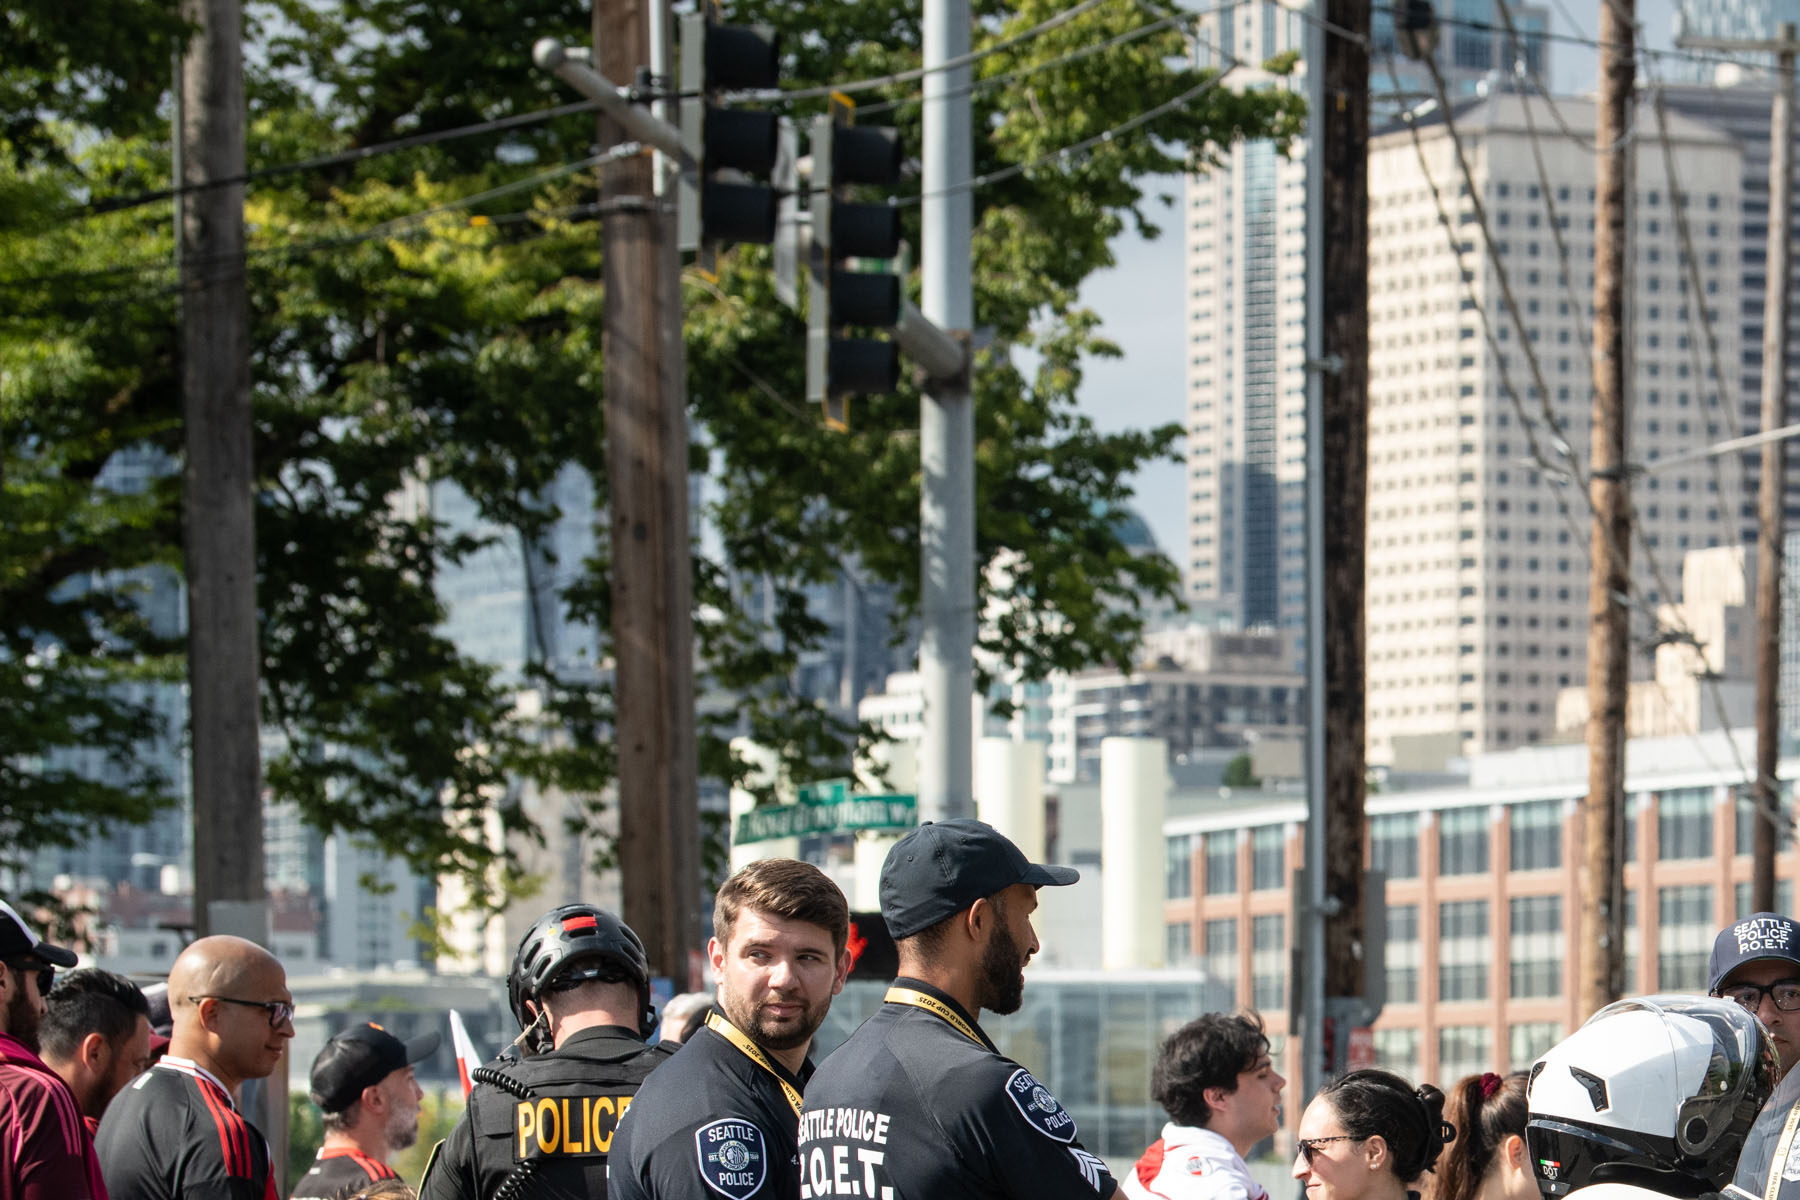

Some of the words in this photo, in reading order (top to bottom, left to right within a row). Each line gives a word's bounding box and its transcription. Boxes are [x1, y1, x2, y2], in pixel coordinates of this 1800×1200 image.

[1733, 918, 1793, 936] SEATTLE
[1737, 928, 1789, 945] POLICE
[1739, 938, 1789, 955] P.O.E.T.
[919, 996, 937, 1008] 2025
[936, 1006, 950, 1016] CUP
[745, 1044, 760, 1058] 2025
[836, 1107, 891, 1145] POLICE
[1043, 1111, 1071, 1131] POLICE
[707, 1125, 755, 1142] SEATTLE
[718, 1172, 755, 1186] POLICE
[1542, 1165, 1559, 1177] DOT
